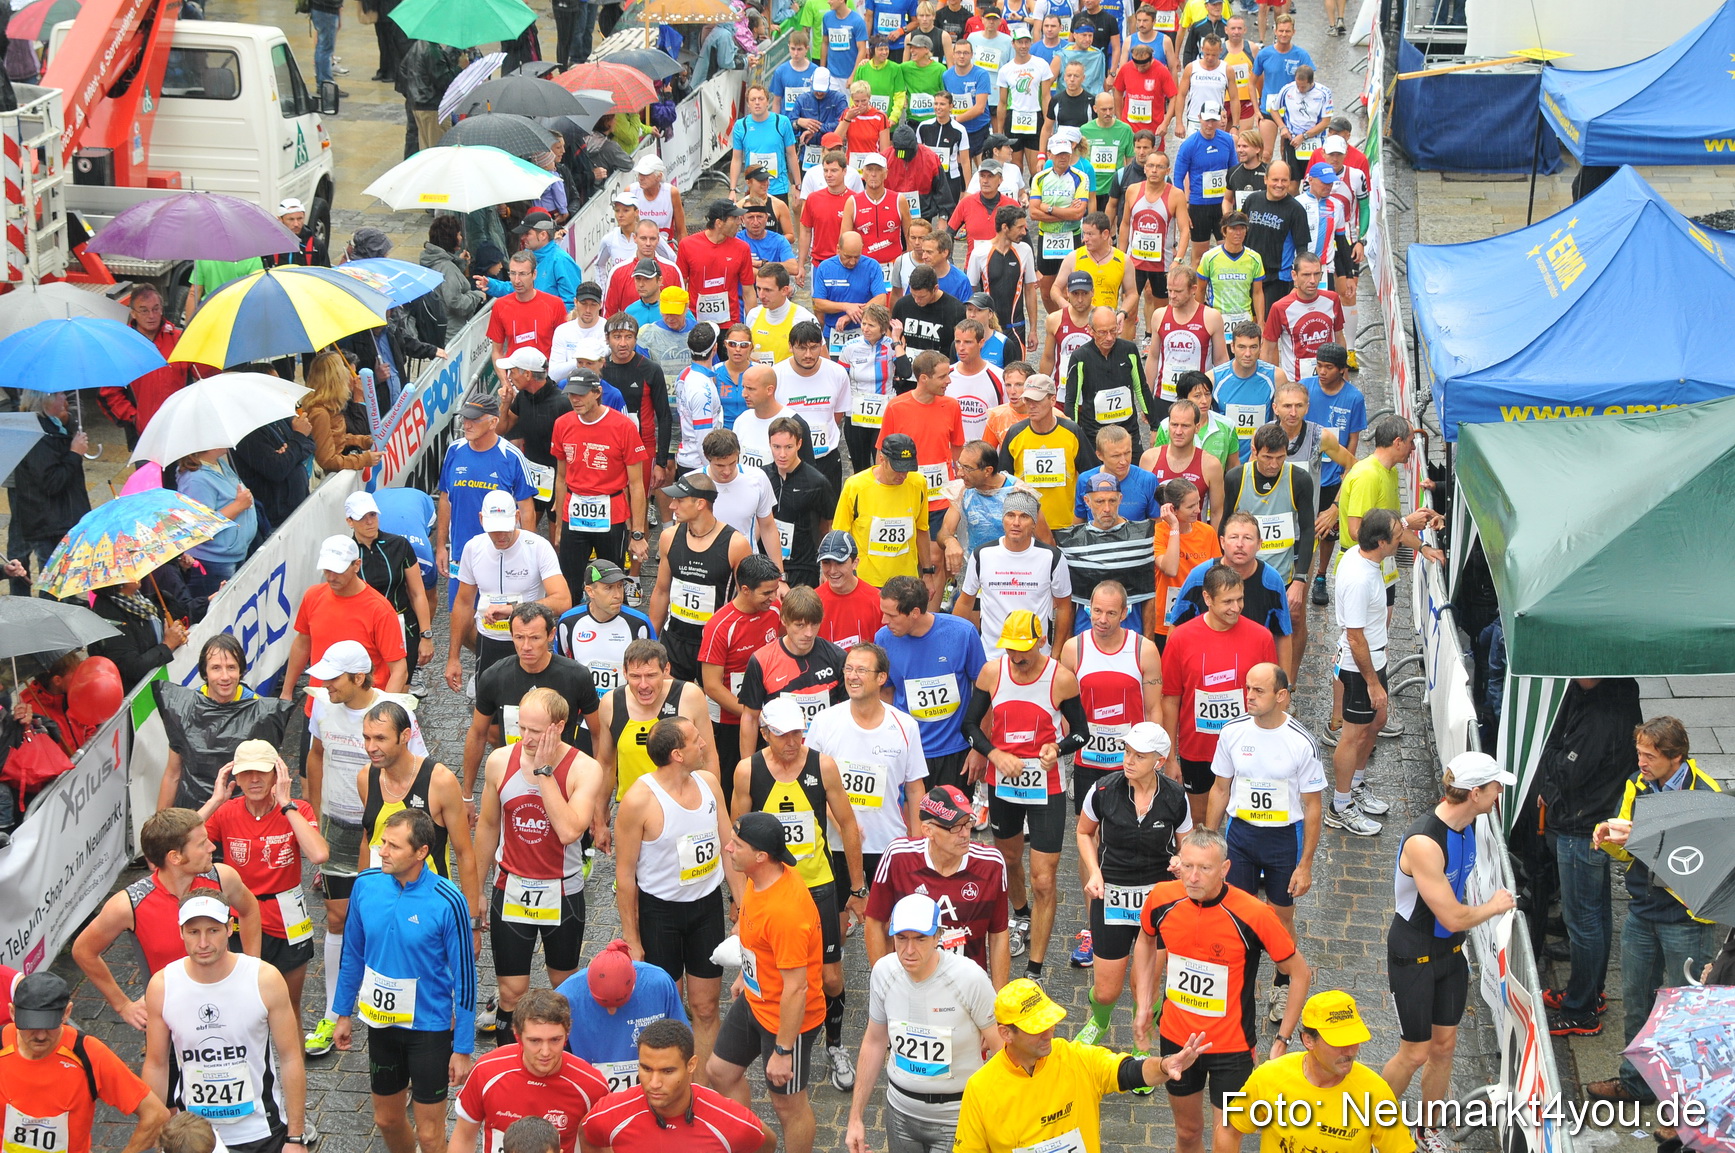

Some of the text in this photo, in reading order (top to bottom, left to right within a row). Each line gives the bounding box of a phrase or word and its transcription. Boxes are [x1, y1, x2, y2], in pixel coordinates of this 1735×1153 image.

[880, 18, 900, 28] 2043
[830, 33, 848, 42] 2107
[980, 52, 996, 62] 282
[912, 100, 934, 109] 2055
[1131, 106, 1146, 115] 311
[1016, 116, 1032, 125] 822
[1301, 142, 1317, 151] 816
[1096, 153, 1113, 162] 383
[1212, 178, 1222, 188] 93
[1046, 238, 1070, 249] 2237
[1138, 240, 1156, 251] 159
[699, 300, 726, 313] 2351
[917, 320, 941, 338] TX
[1304, 330, 1328, 341] LAC
[860, 402, 881, 416] 157
[1106, 398, 1122, 410] 72
[1102, 409, 1132, 420] Reinhard
[1238, 414, 1254, 426] 94
[1036, 459, 1053, 474] 62
[454, 480, 498, 491] LAC QUELLE
[1032, 476, 1058, 484] Johannes
[572, 503, 606, 518] 3094
[878, 528, 906, 543] 283
[1262, 524, 1282, 539] 75
[883, 544, 900, 552] Peter
[1260, 540, 1284, 550] Gerhard
[683, 593, 700, 610] 15
[680, 609, 699, 620] Martin
[592, 670, 619, 688] 091
[814, 666, 834, 680] T90
[918, 688, 950, 708] 312
[924, 708, 948, 717] Fabian
[1199, 700, 1240, 718] 2035
[1087, 734, 1126, 752] 2033
[1096, 754, 1118, 764] Rainer
[59, 728, 122, 834] Xplus1
[842, 772, 876, 794] 380
[1000, 770, 1042, 788] 2032
[1014, 790, 1028, 798] Karl
[1250, 791, 1272, 810] 96
[1250, 812, 1273, 820] Martin
[516, 816, 546, 830] LAC
[696, 842, 714, 864] 63
[691, 862, 716, 877] Christian
[520, 890, 544, 906] 47
[962, 889, 977, 897] FCN
[524, 909, 539, 918] Kurt
[1178, 971, 1214, 996] 202
[372, 988, 396, 1011] 98
[1180, 994, 1209, 1008] Herbert
[368, 1010, 396, 1024] Helmut
[895, 1035, 944, 1062] 2212
[910, 1063, 926, 1074] Uwe
[192, 1080, 244, 1104] 3247
[201, 1108, 240, 1117] Christian
[1041, 1109, 1063, 1124] swn
[14, 1126, 56, 1150] 810
[1320, 1125, 1346, 1138] swn
